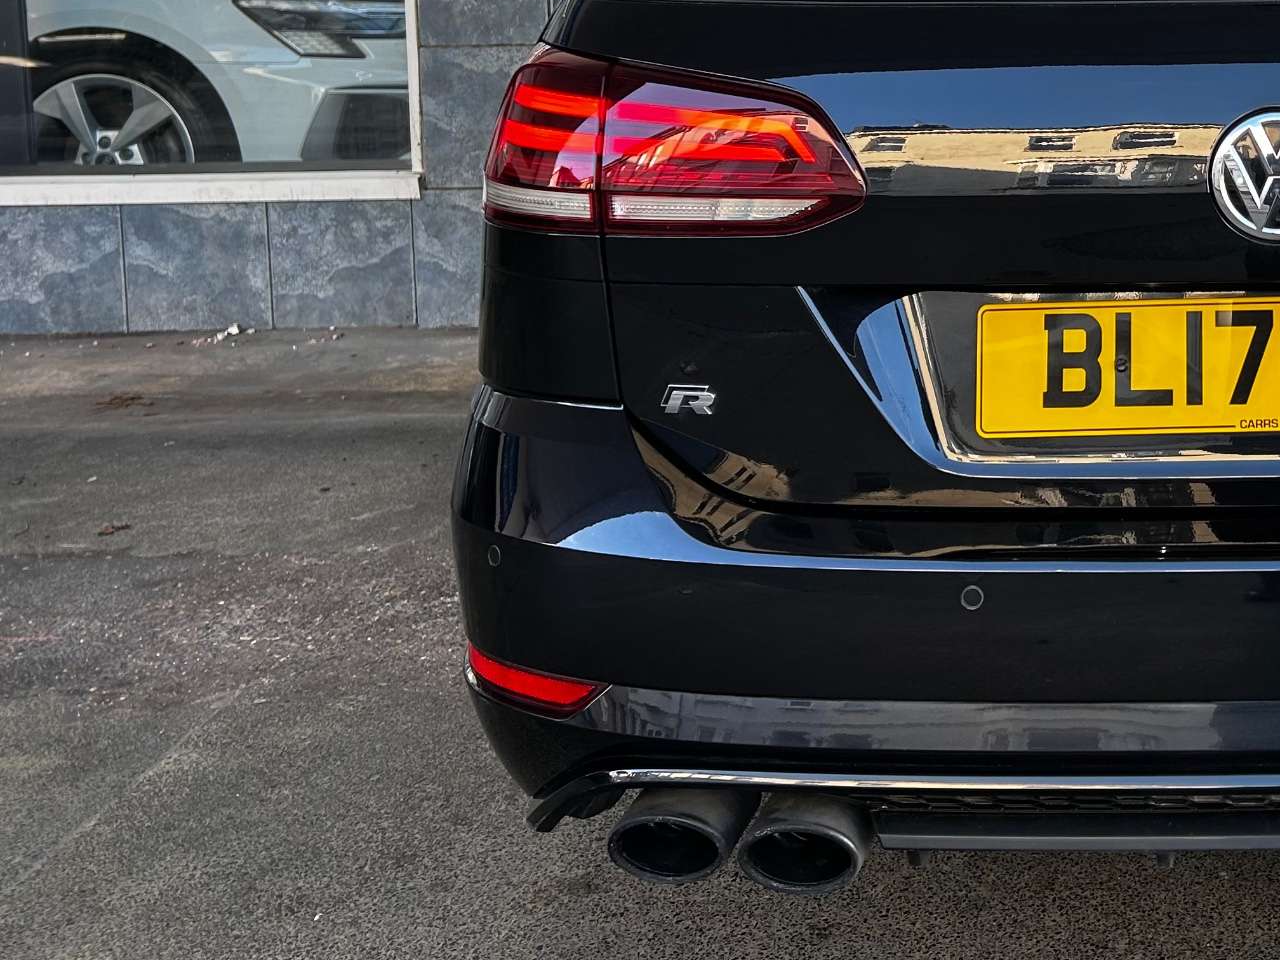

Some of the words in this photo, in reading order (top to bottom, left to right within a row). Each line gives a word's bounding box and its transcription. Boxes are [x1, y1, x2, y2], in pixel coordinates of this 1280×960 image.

[1042, 309, 1275, 409] BL17
[663, 387, 715, 415] R
[1239, 418, 1279, 429] CARRS
